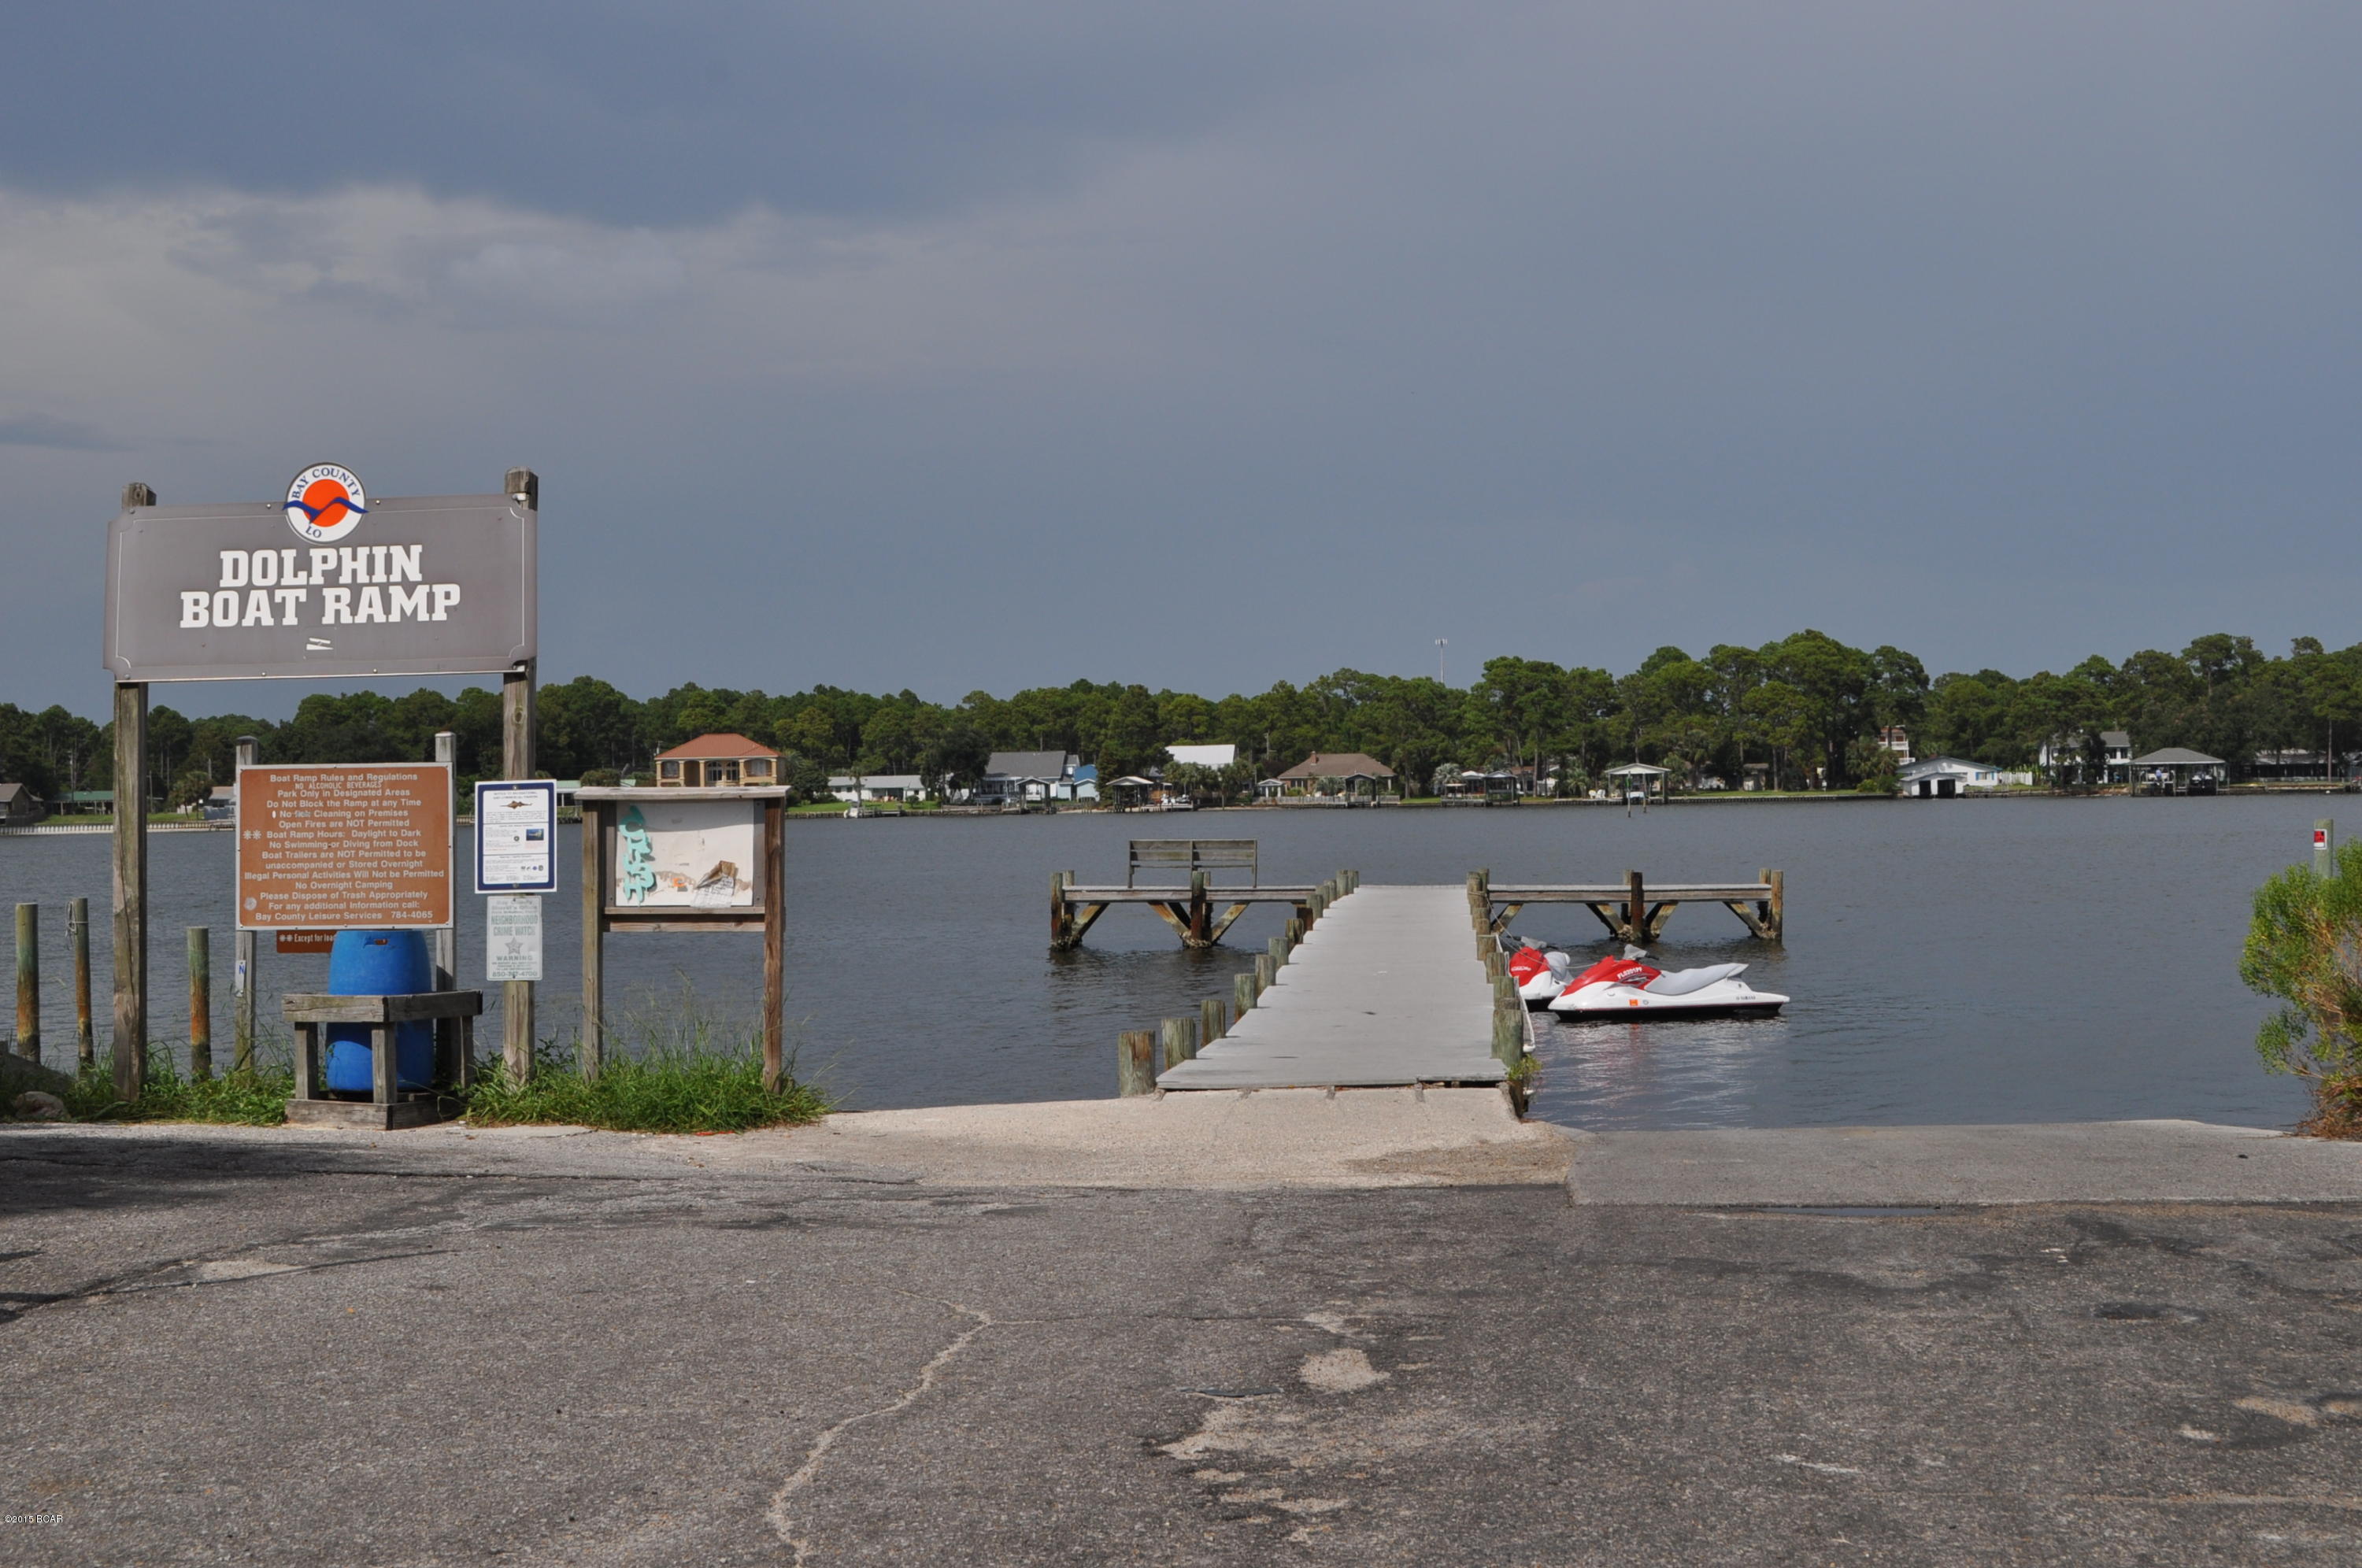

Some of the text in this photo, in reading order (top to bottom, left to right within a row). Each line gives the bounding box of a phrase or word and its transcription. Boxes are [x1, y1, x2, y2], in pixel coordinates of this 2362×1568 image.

[291, 467, 360, 499] BAY COUNTY
[220, 545, 423, 587] DOLPHIN
[180, 584, 461, 628] BOAT RAMP
[367, 774, 417, 782] Regulations
[300, 790, 320, 798] Only
[334, 790, 382, 798] Designated
[314, 810, 351, 819] Cleaning
[279, 820, 302, 829] Open
[290, 830, 314, 839] Ramp
[284, 841, 328, 849] Swimming
[266, 861, 333, 870] unaccompanied
[381, 860, 423, 869] Overnight
[292, 892, 328, 900] Dispose
[369, 891, 428, 900] Appropriately
[275, 912, 305, 921] County
[294, 933, 313, 944] Except
[314, 933, 323, 941] for
